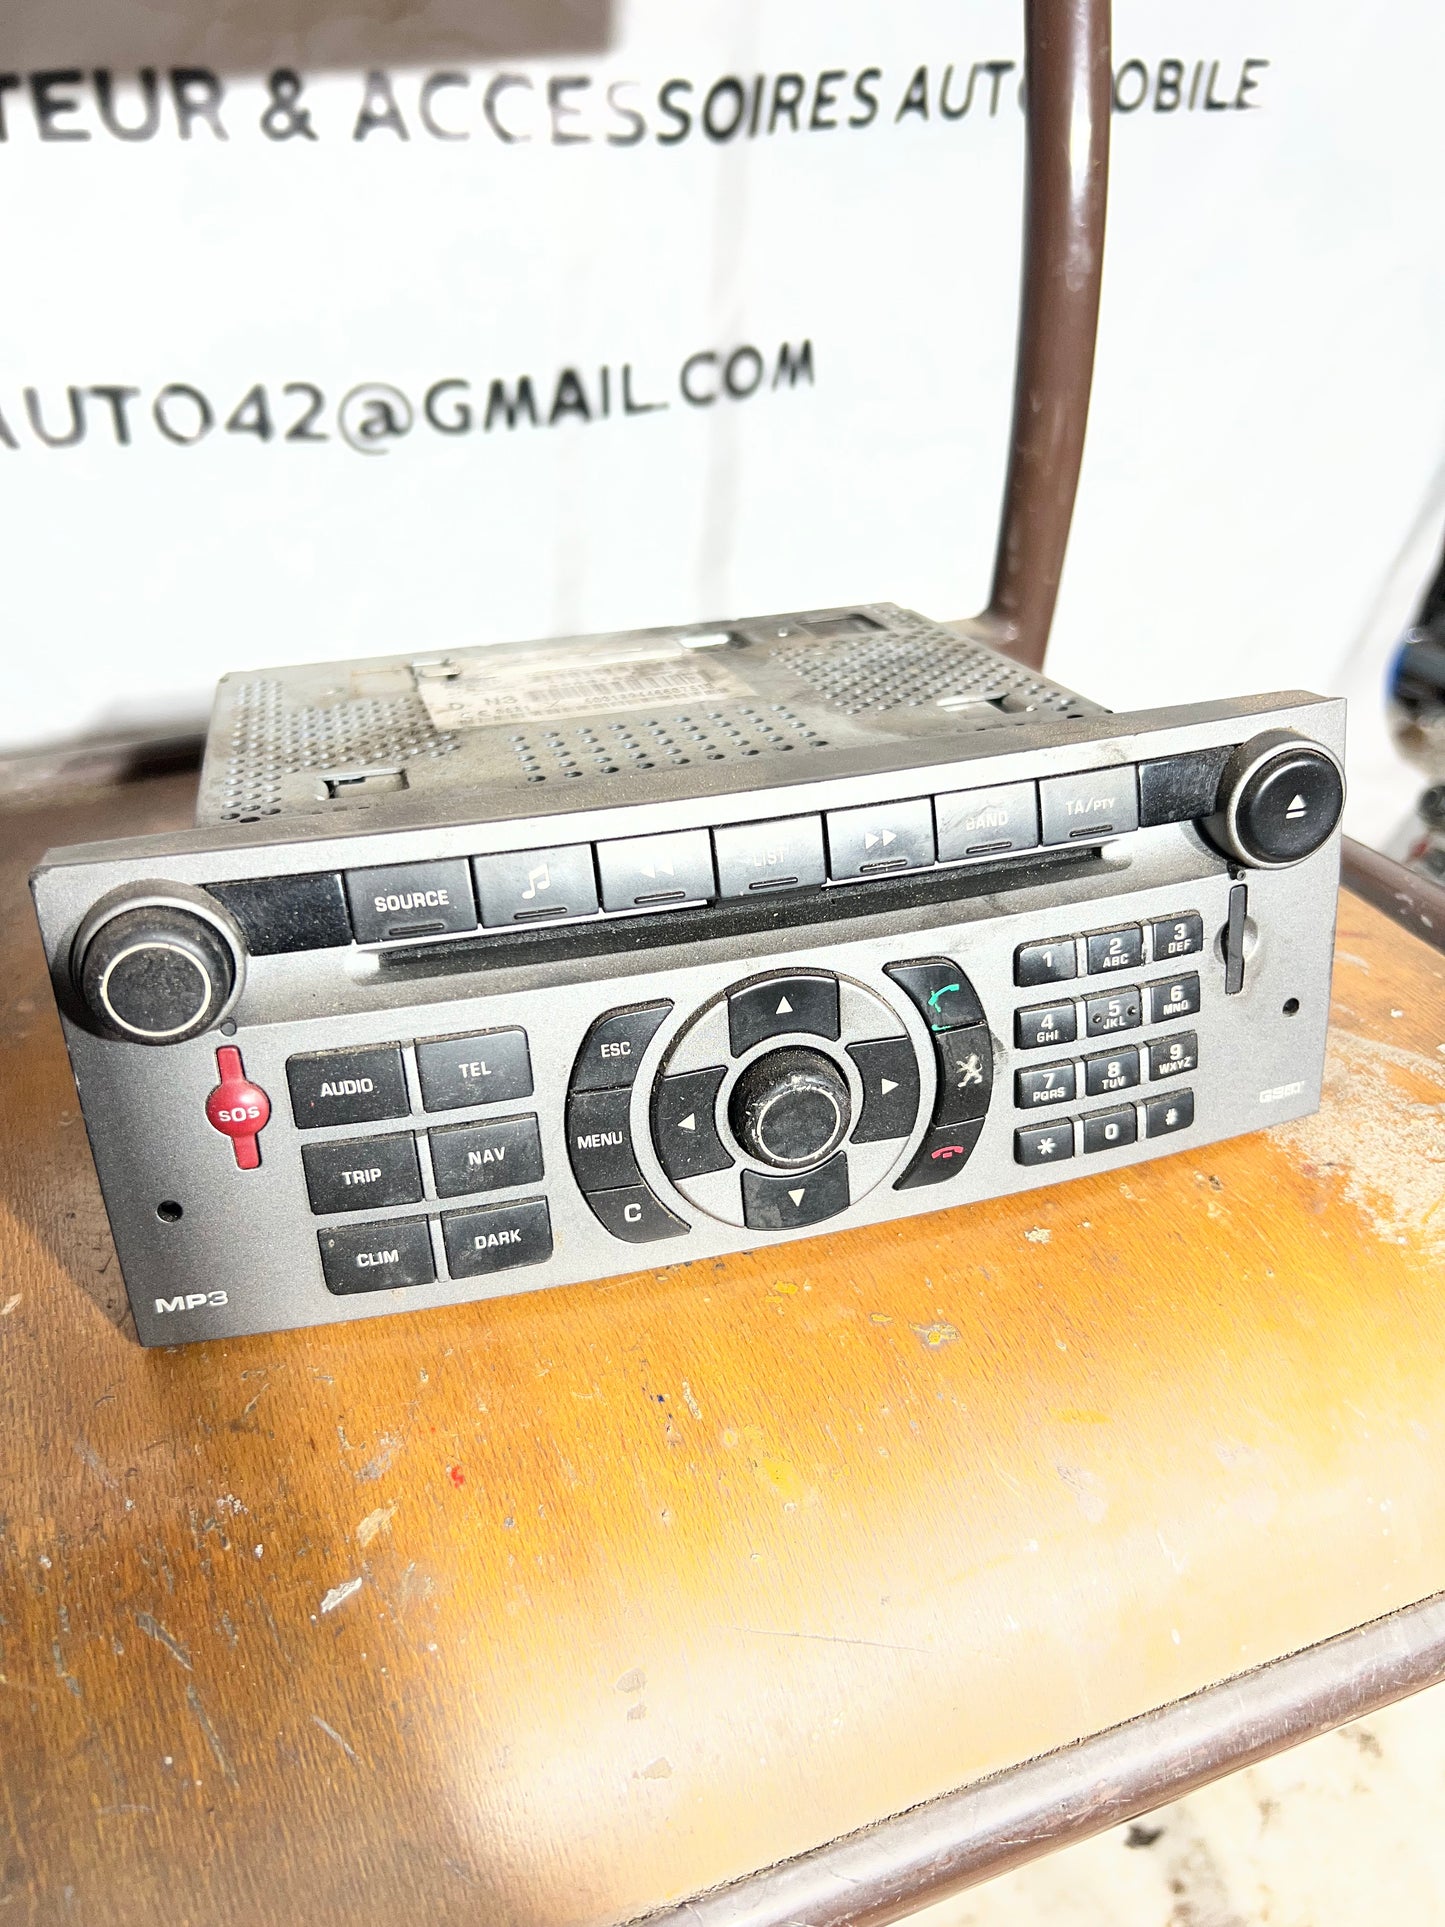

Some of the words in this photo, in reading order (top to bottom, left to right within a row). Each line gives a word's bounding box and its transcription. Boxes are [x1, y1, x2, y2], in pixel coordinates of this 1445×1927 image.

[260, 67, 319, 142] &
[352, 66, 882, 146] ACCESSOIRES
[895, 58, 1271, 124] AUTOBILE
[1064, 797, 1116, 816] TA/PTY
[965, 810, 1009, 831] BAND
[752, 846, 787, 867] LIST
[374, 889, 450, 913] SOURCE
[1173, 923, 1186, 941] 3
[1108, 938, 1122, 954] 2
[1168, 939, 1192, 954] DEF
[1041, 951, 1053, 968] 1
[1102, 953, 1129, 968] ABC
[1170, 985, 1183, 1001] 6
[1108, 1000, 1122, 1017] 5
[1163, 1000, 1189, 1015] MNO
[1040, 1014, 1054, 1030] 4
[1103, 1016, 1126, 1030] JKL
[1036, 1030, 1059, 1043] GHI
[600, 1041, 632, 1058] ESC
[1169, 1044, 1184, 1060] 9
[458, 1062, 492, 1079] TEL
[1107, 1061, 1121, 1078] 8
[1159, 1059, 1192, 1075] WXYZ
[320, 1078, 374, 1098] AUDIO
[1042, 1073, 1055, 1089] 7
[1101, 1076, 1126, 1090] TUV
[1032, 1087, 1065, 1102] PQRS
[218, 1104, 261, 1123] SOS
[576, 1130, 624, 1149] MENU
[468, 1146, 506, 1165] NAV
[342, 1168, 382, 1186] TRIP
[624, 1203, 642, 1223] C
[474, 1228, 522, 1251] DARK
[356, 1249, 399, 1268] CLIM
[155, 1290, 229, 1314] MP3
